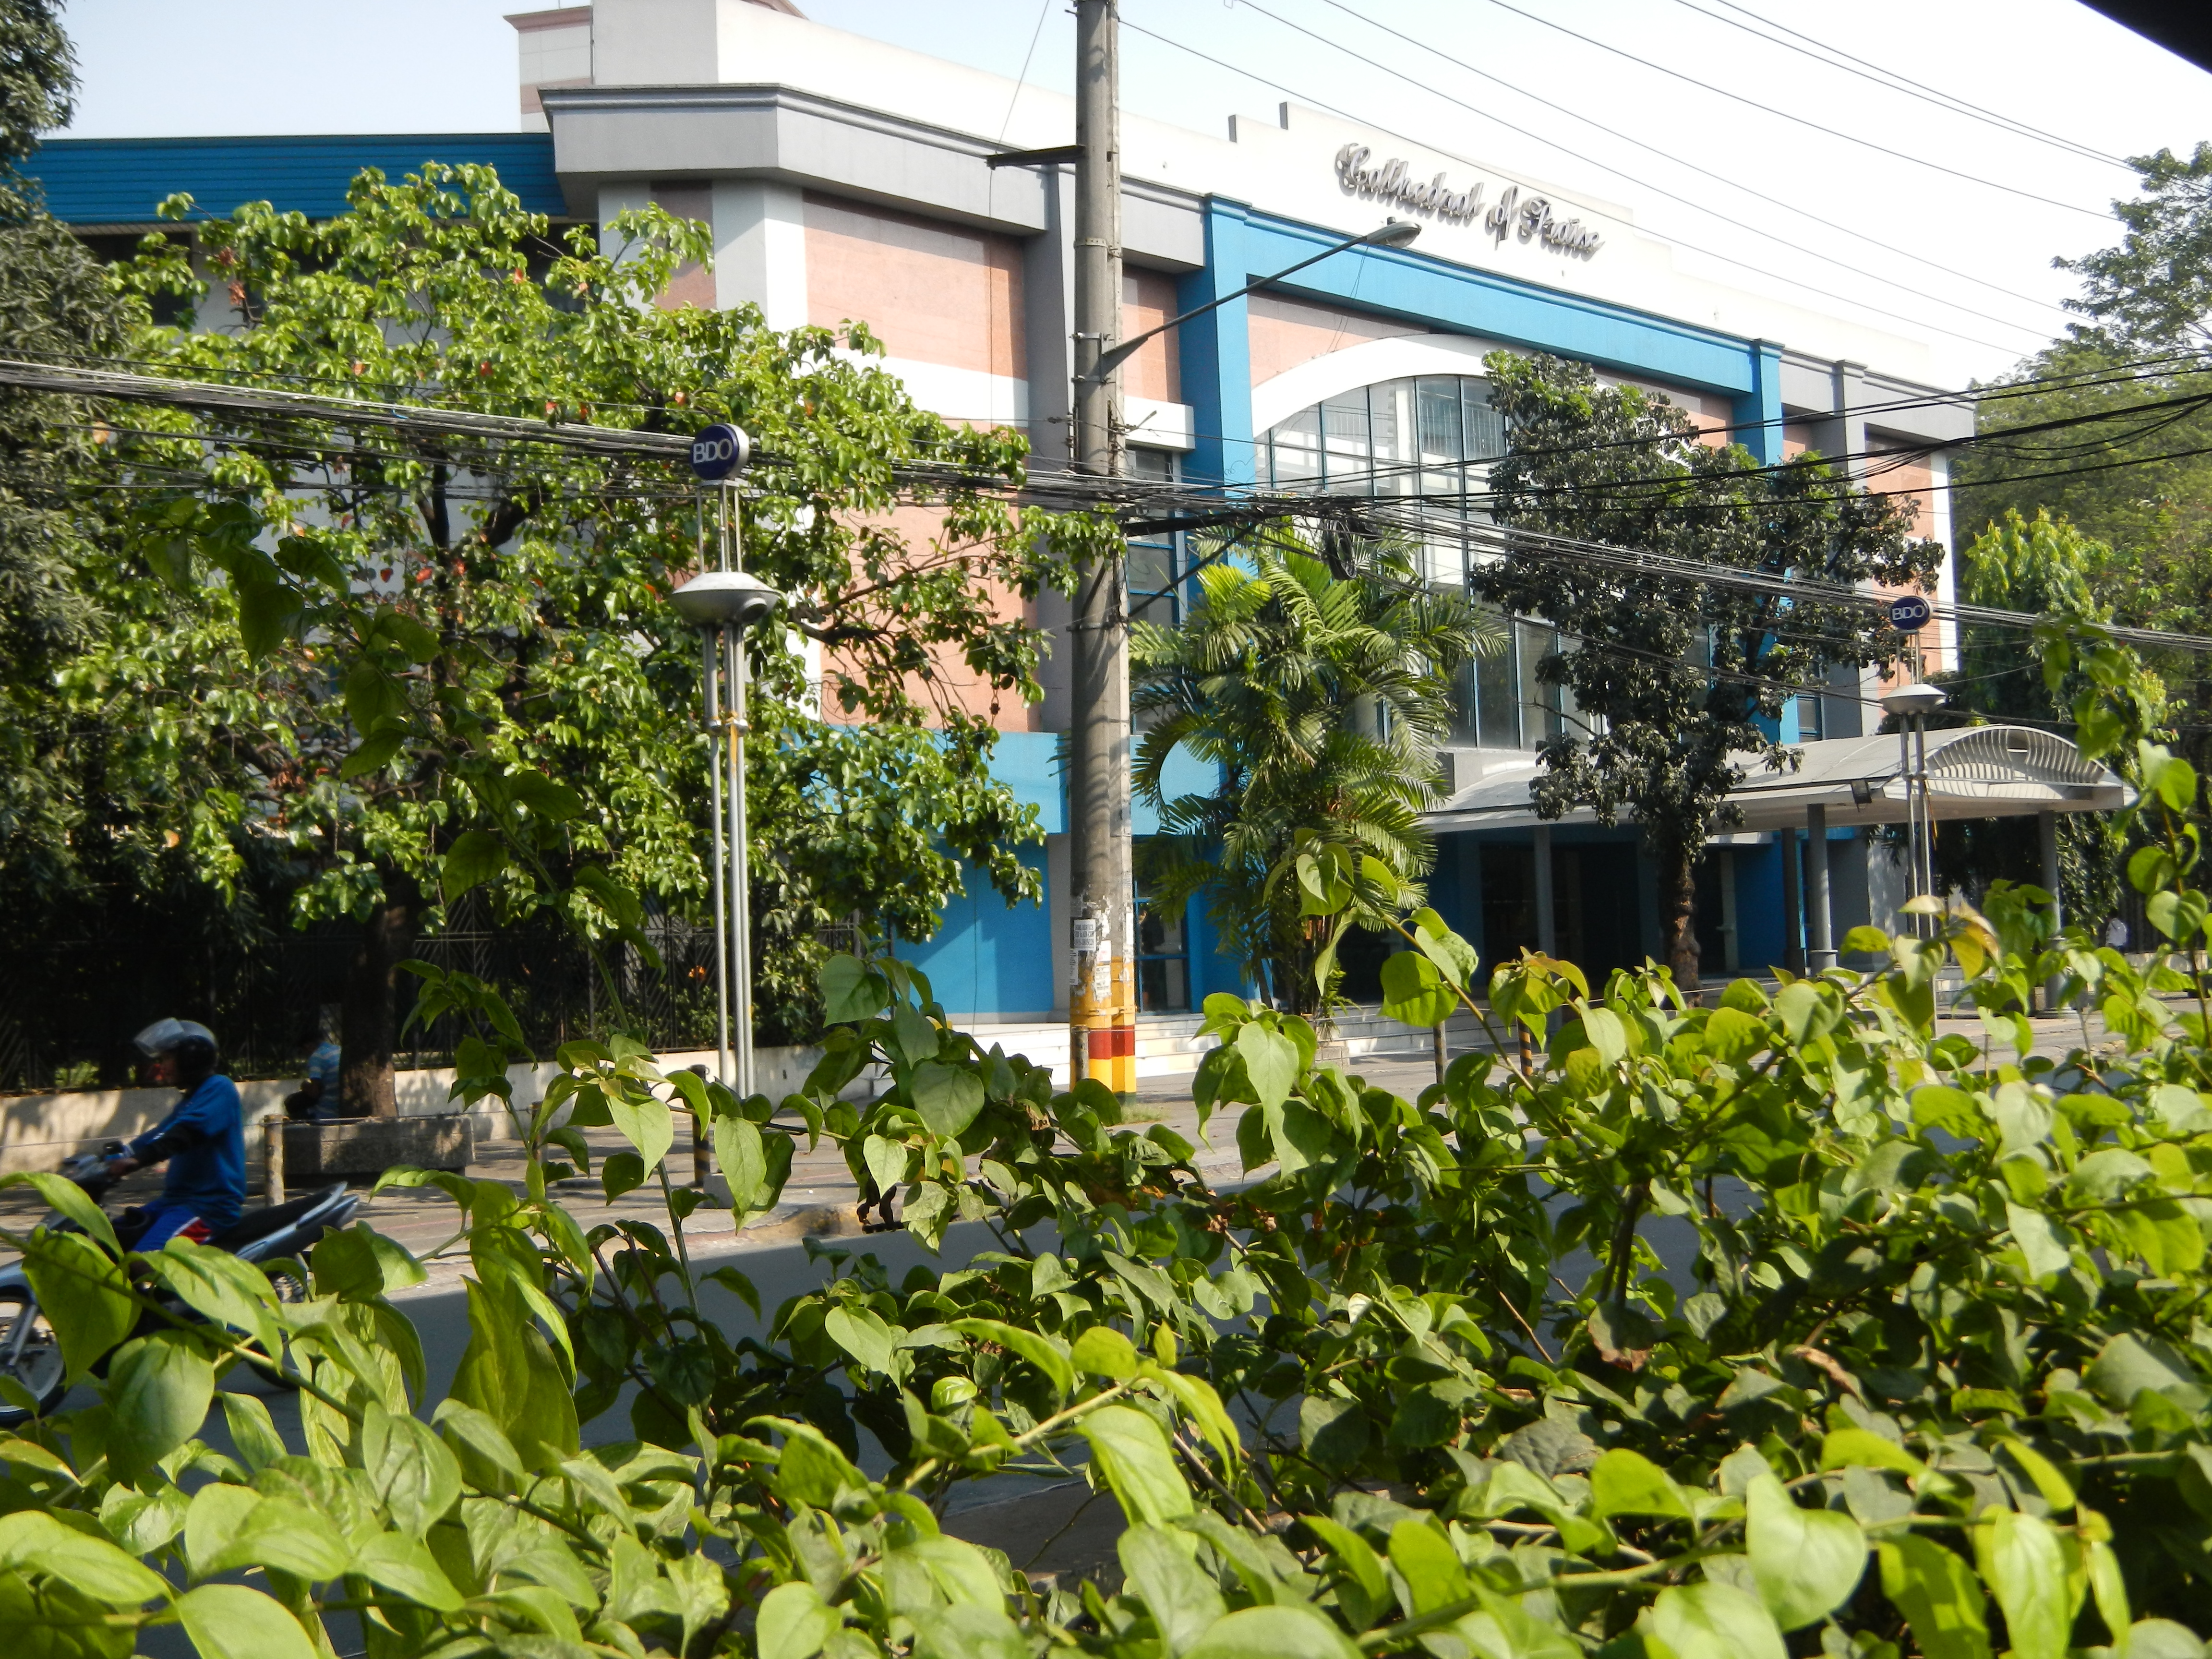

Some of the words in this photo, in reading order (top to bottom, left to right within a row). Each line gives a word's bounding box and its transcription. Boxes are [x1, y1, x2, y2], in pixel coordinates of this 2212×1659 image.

[1335, 143, 1486, 217] Cathedral
[1489, 185, 1521, 251] of
[693, 438, 733, 463] BDO
[1892, 605, 1925, 620] BDO
